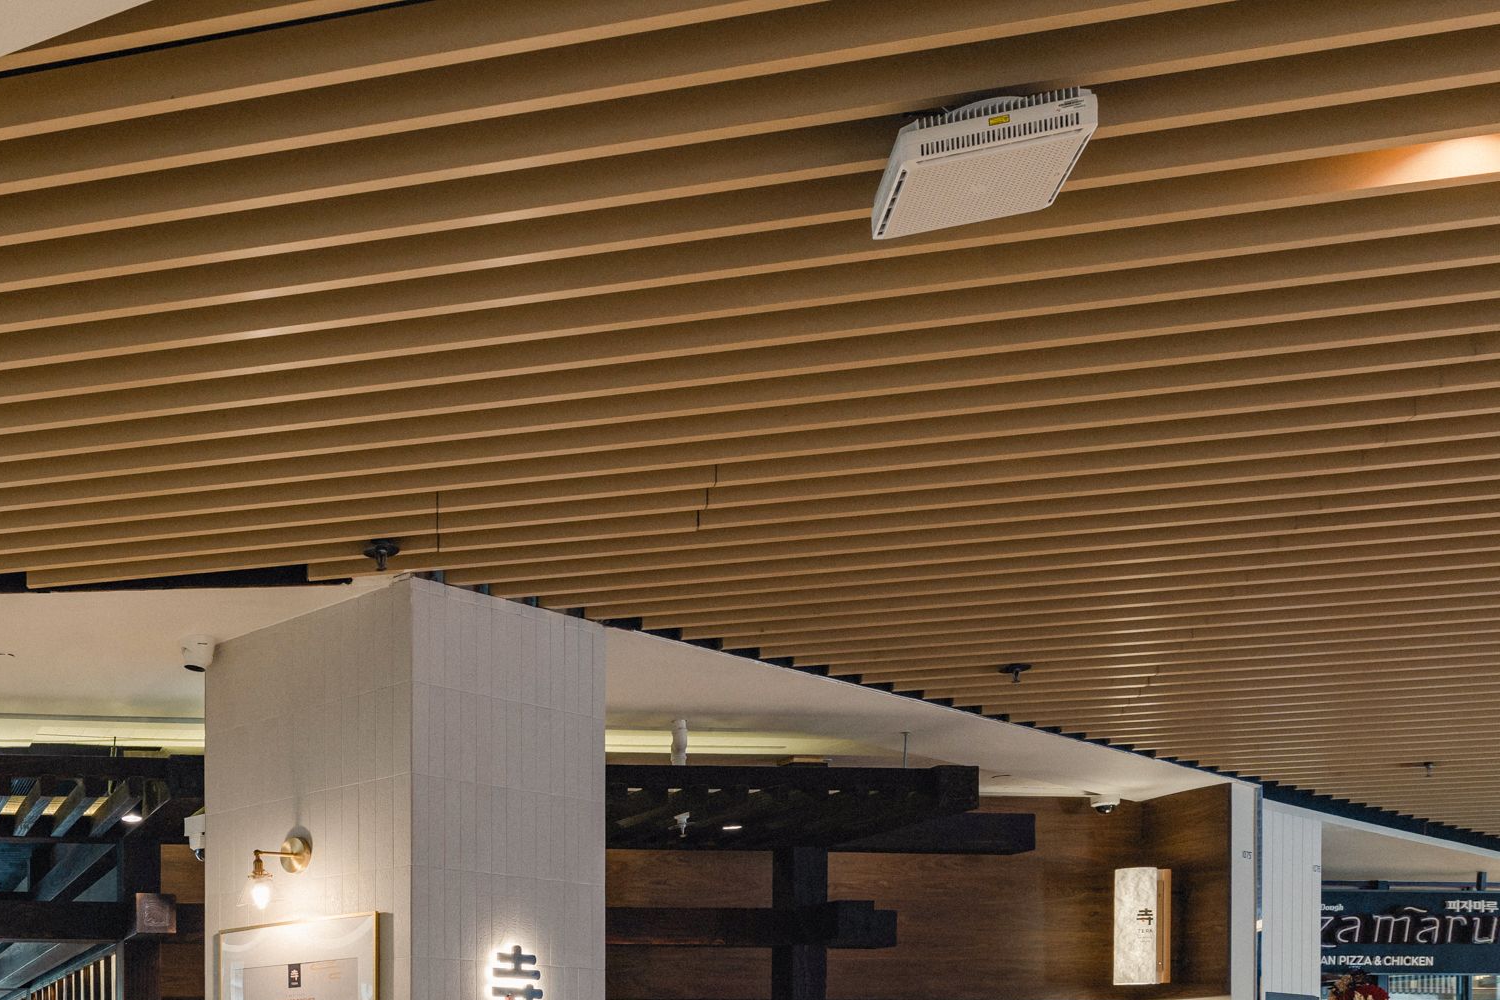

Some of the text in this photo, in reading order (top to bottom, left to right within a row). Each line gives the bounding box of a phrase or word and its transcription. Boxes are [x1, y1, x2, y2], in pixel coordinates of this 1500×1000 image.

[1445, 900, 1499, 913] 피자마루
[1339, 955, 1372, 966] PIZZA
[1374, 955, 1382, 966] &
[1384, 955, 1434, 966] CHICKEN
